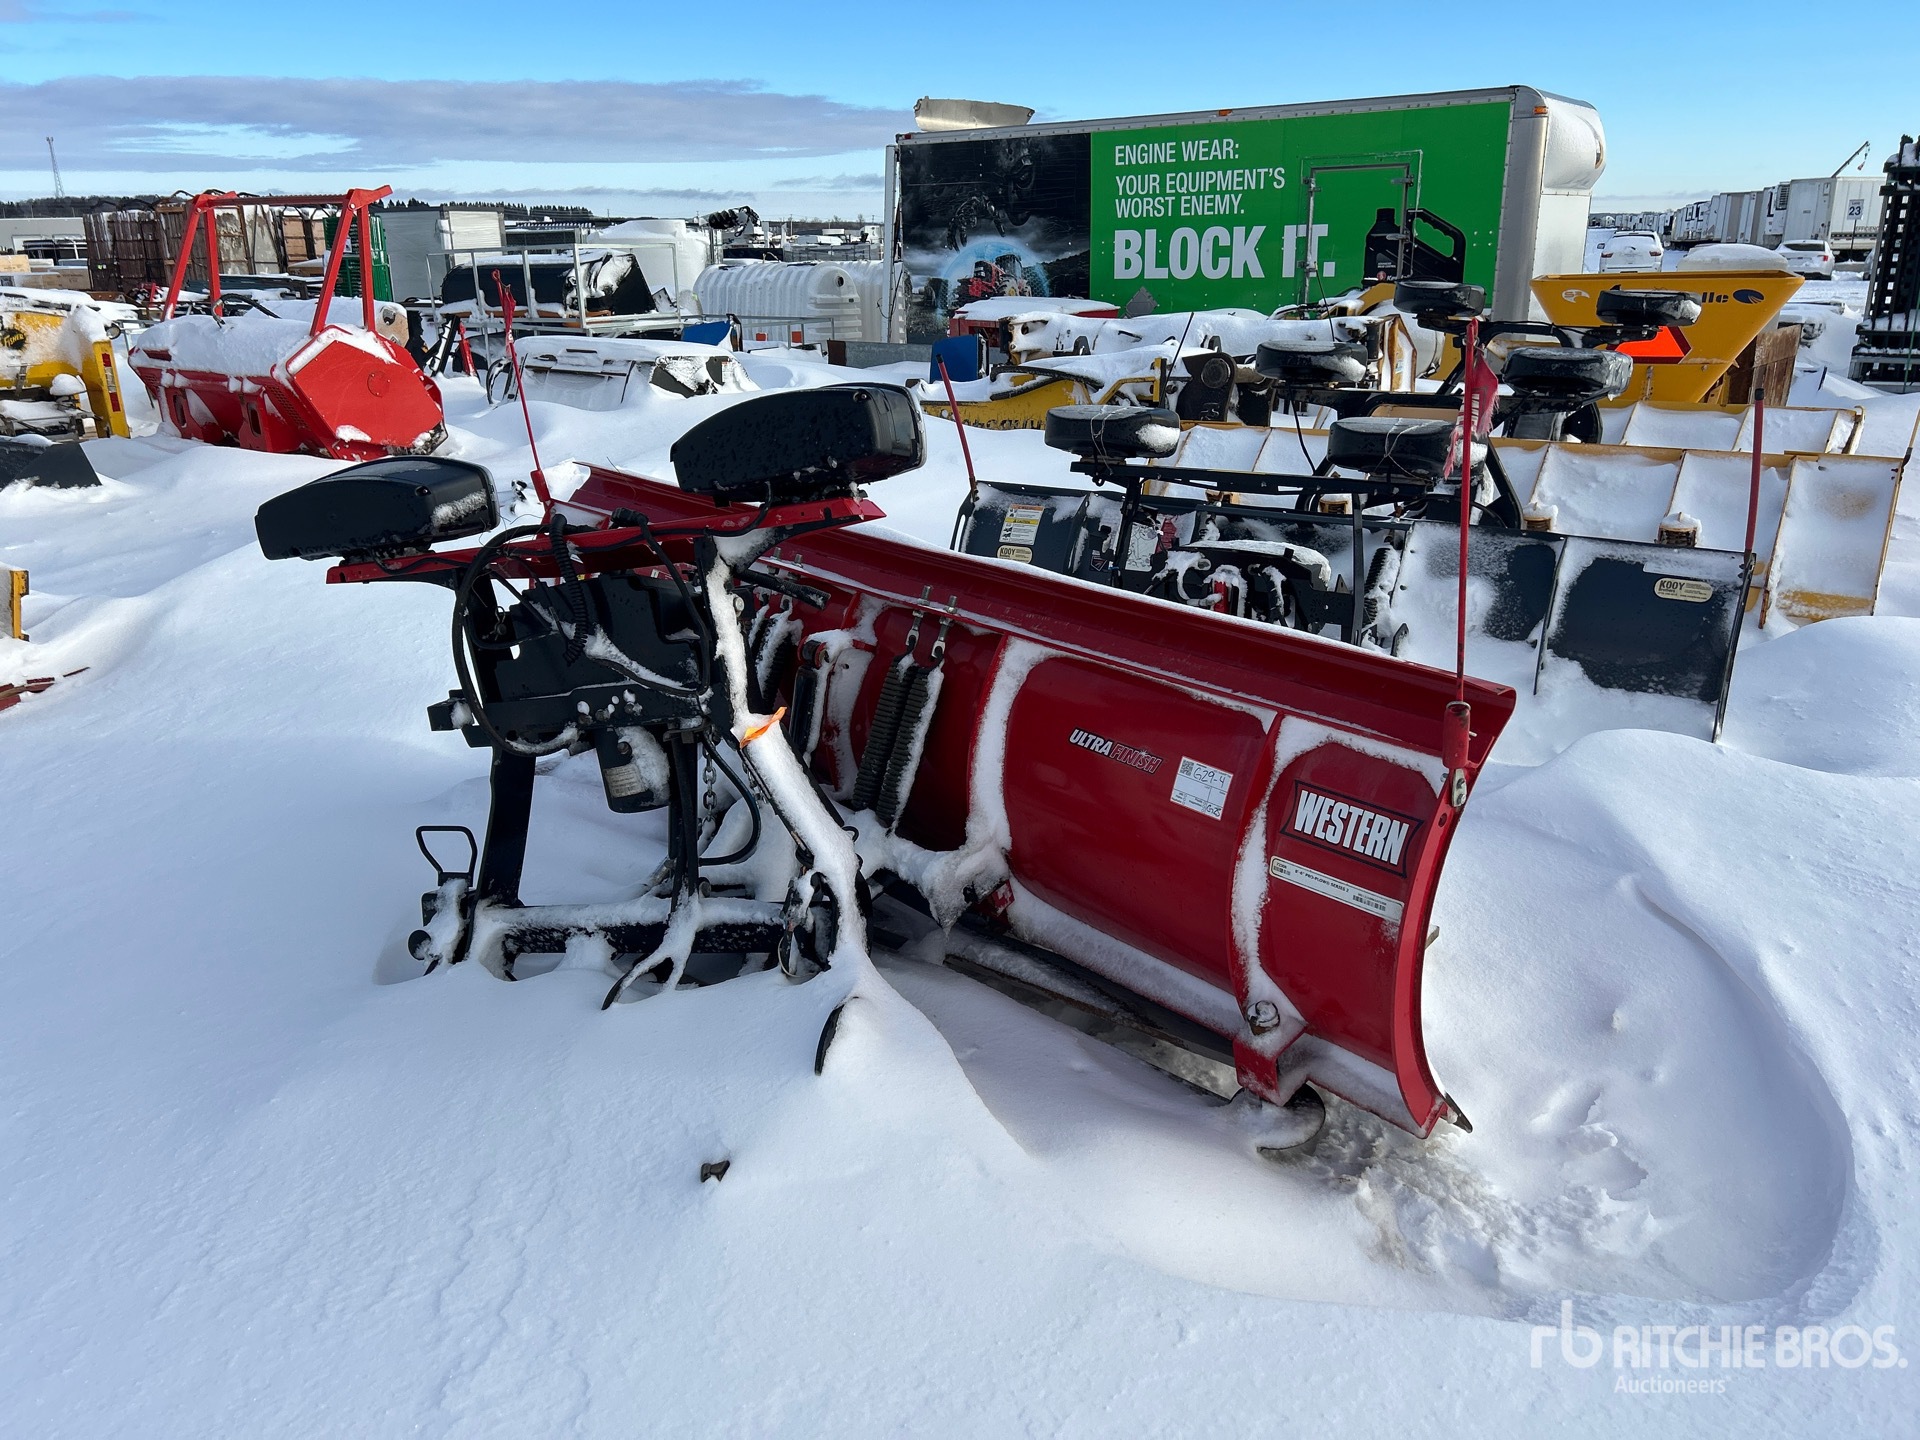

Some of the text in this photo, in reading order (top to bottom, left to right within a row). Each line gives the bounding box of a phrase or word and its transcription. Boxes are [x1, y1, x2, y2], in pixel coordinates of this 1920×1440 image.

[1115, 138, 1240, 166] ENGINE WEAR:
[1116, 167, 1285, 196] YOUR EQUIPMENT'S
[1115, 193, 1245, 218] WORST ENEMY.
[1848, 206, 1861, 216] 23
[1114, 224, 1336, 280] BLOCK IT.
[4, 334, 24, 348] FISHER
[1000, 547, 1016, 555] KOOY
[1659, 580, 1685, 591] KOOY
[1069, 728, 1163, 774] ULTRA FINISH
[1193, 767, 1226, 788] G29-4
[1294, 790, 1410, 866] WESTERN
